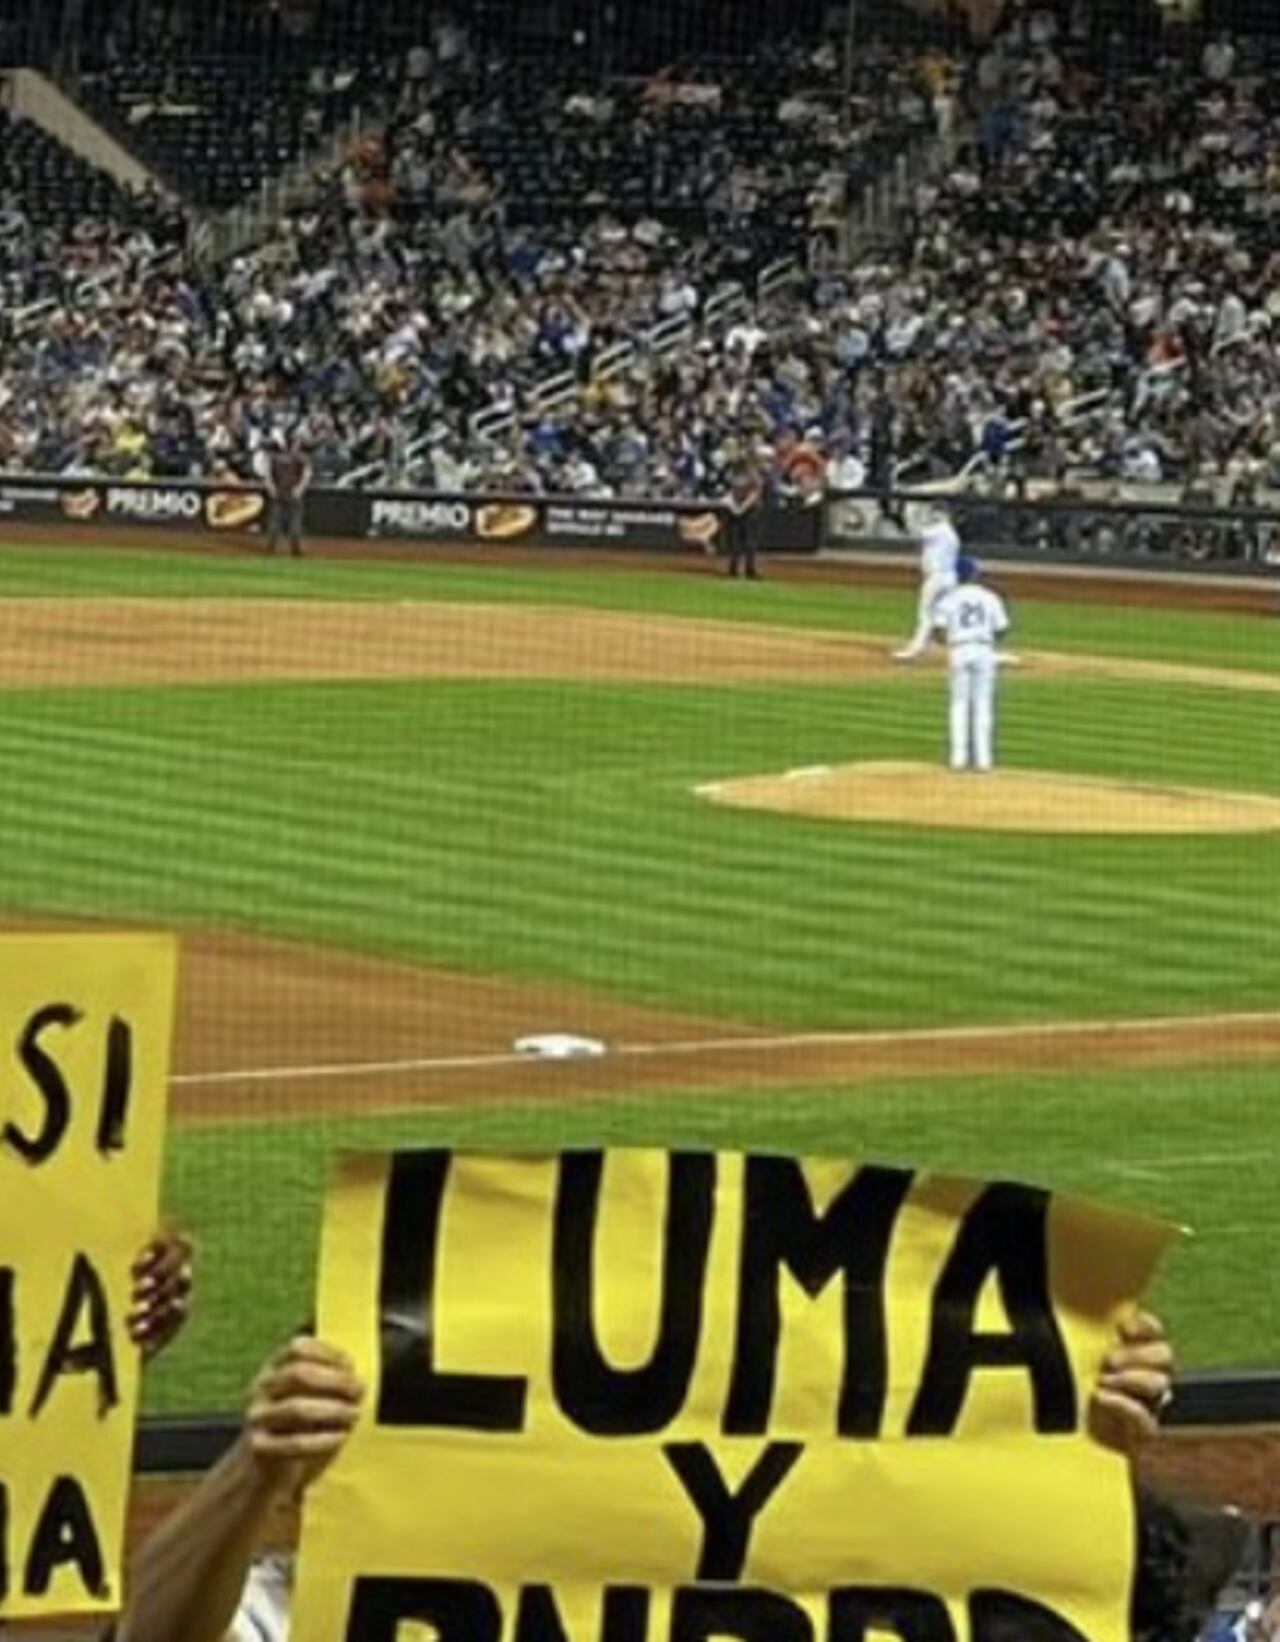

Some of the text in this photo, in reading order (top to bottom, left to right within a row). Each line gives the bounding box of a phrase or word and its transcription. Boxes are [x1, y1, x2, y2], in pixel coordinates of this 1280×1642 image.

[106, 487, 202, 515] PREMIO
[370, 499, 470, 527] PREMIO
[376, 1147, 1078, 1439] LUMA
[663, 1441, 805, 1583] Y
